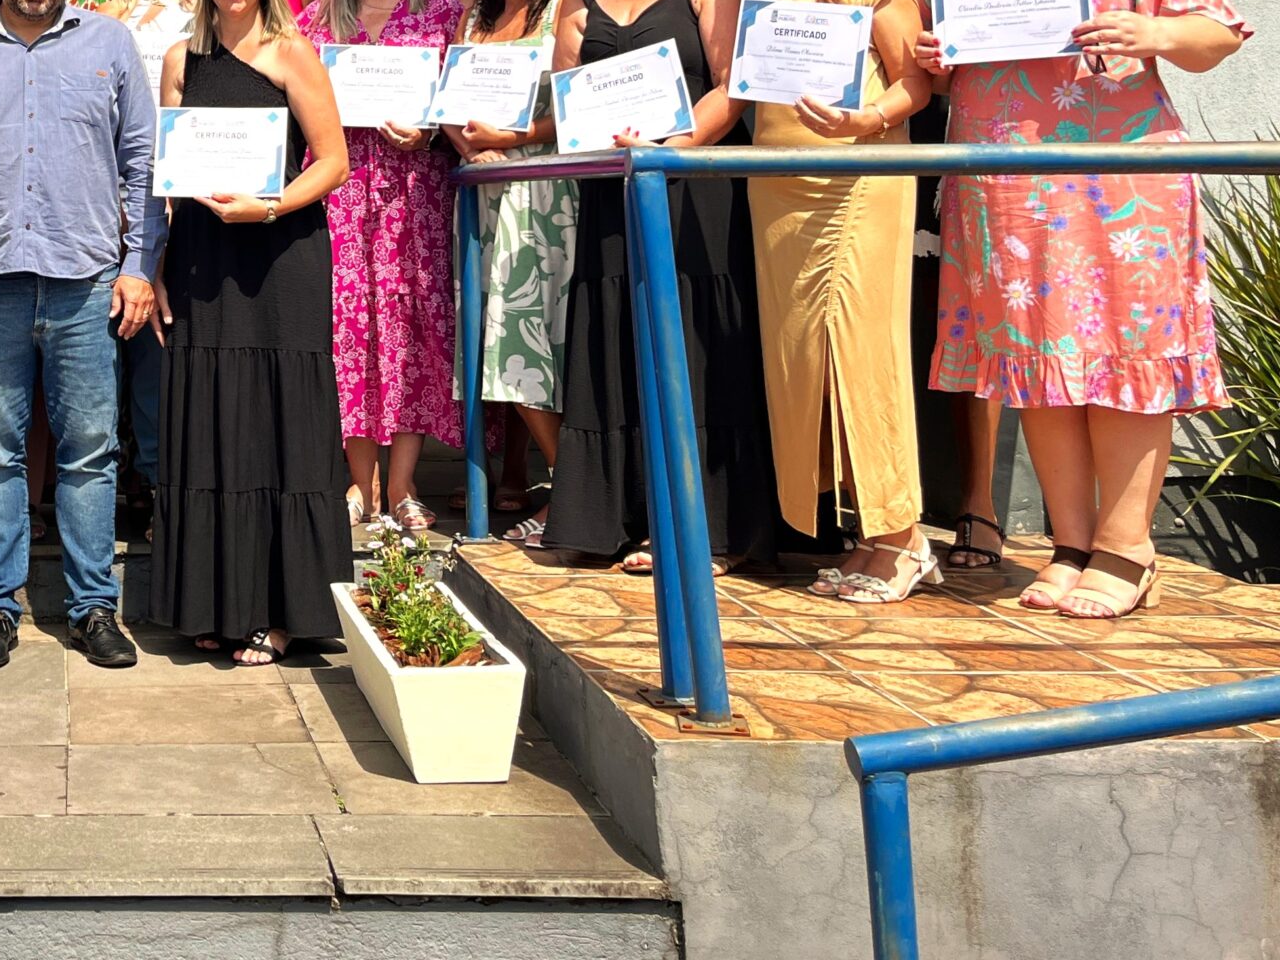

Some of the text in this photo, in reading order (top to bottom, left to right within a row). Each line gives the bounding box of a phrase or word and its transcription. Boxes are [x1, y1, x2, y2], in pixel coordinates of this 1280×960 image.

[774, 27, 827, 40] CERTIFICADO
[355, 67, 404, 75] CERTIFICADO
[471, 67, 512, 76] CERTIFICADO
[592, 72, 644, 92] CERTIFICADO
